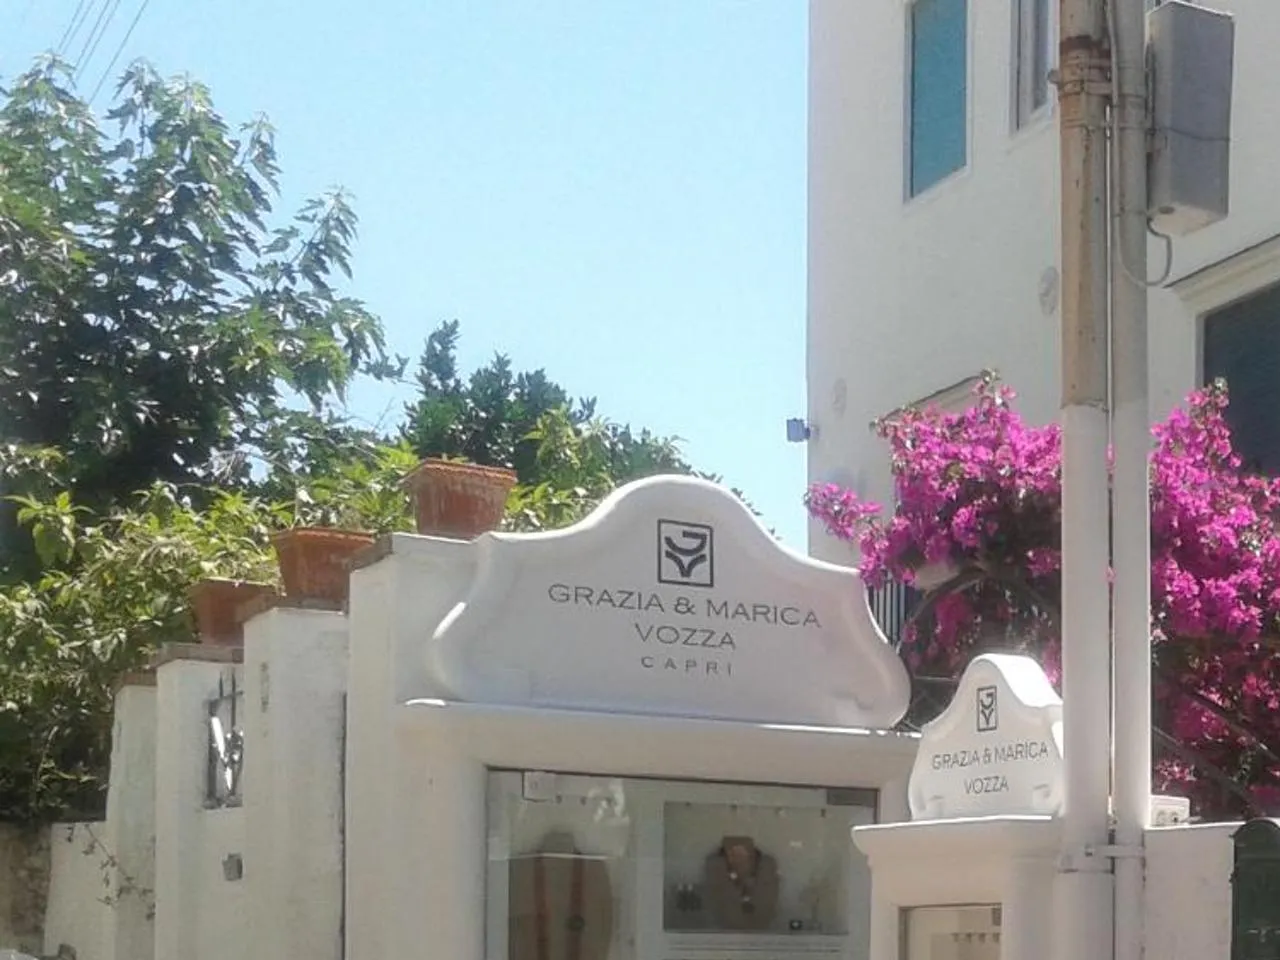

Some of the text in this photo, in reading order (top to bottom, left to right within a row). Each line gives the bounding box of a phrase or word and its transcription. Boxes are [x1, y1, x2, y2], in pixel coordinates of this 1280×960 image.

[548, 583, 822, 629] GRAZIA & MARICA
[634, 622, 737, 651] VOZZA
[640, 655, 734, 677] CAPRI
[931, 741, 1049, 771] GRAZIA & MARICA
[964, 775, 1010, 795] VOZZA
